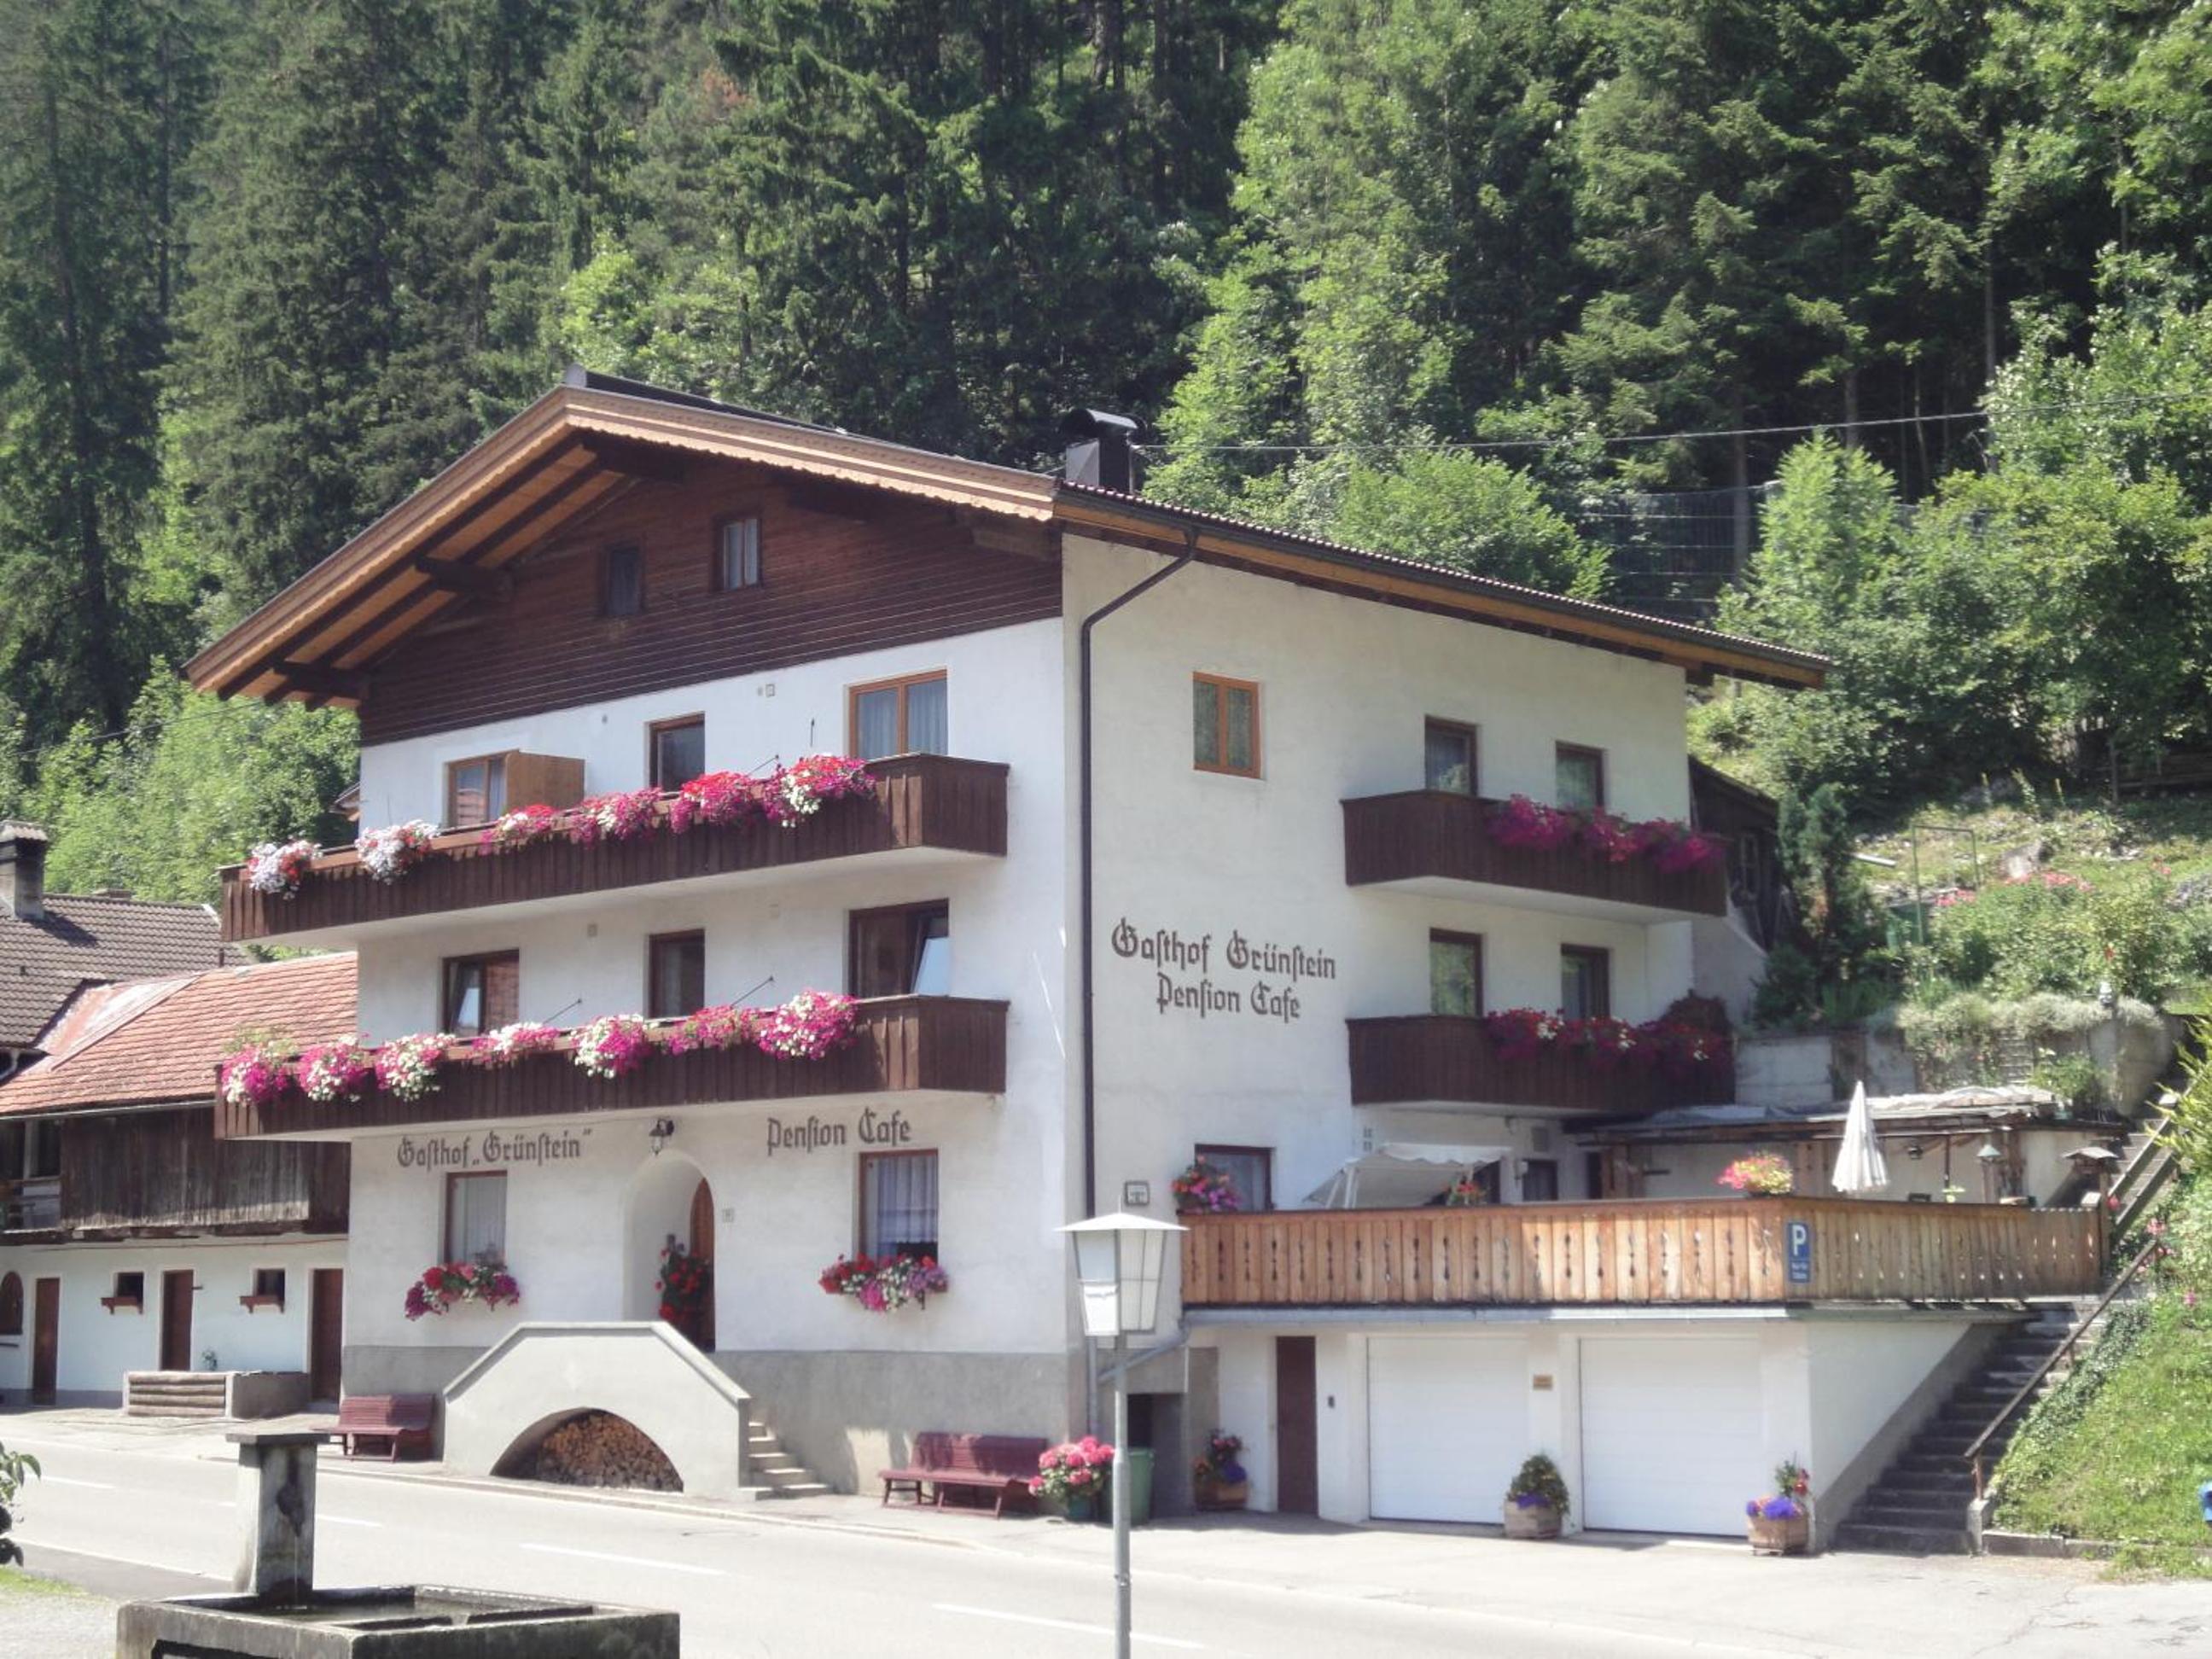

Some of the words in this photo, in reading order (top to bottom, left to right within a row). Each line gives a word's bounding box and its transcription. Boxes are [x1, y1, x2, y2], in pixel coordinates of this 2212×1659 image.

[1111, 917, 1211, 973] Gasthof
[1226, 929, 1336, 981] Grünstein
[1156, 971, 1241, 1018] Pension
[1250, 981, 1300, 1023] Cafe
[398, 1136, 469, 1172] Gasthof
[767, 1116, 847, 1156] Pension
[859, 1106, 911, 1146] Cafe
[1792, 1224, 1807, 1256] P
